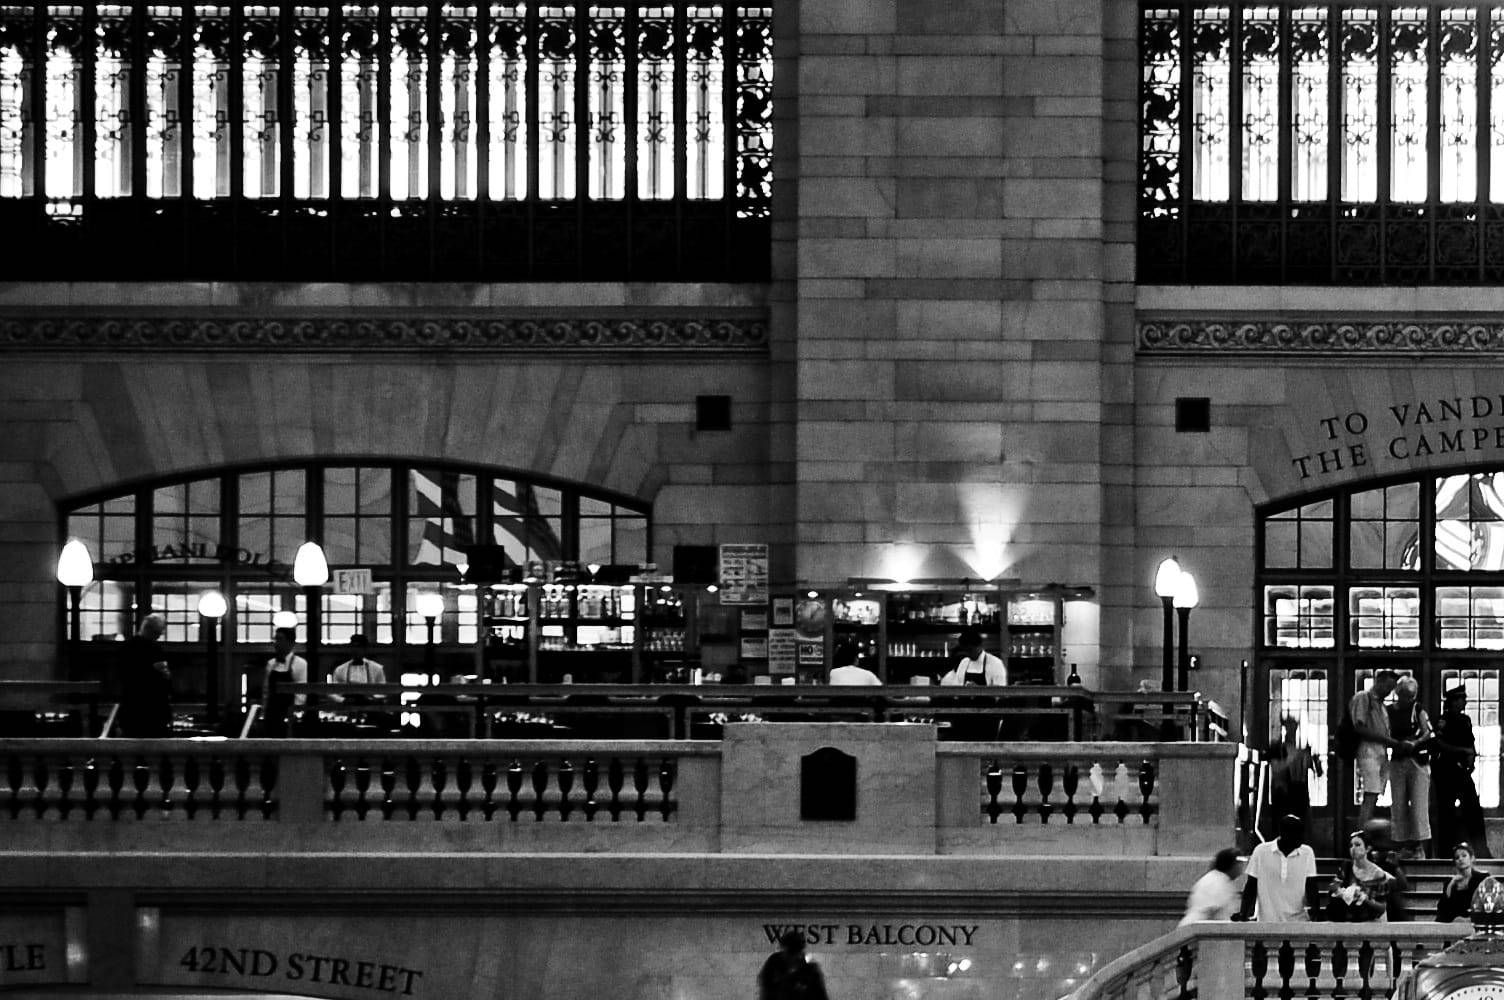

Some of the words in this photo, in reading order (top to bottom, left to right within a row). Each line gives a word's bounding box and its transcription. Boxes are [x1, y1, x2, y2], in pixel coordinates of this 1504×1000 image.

[1320, 412, 1368, 440] TO
[1292, 444, 1367, 478] THE
[846, 924, 979, 946] BALCONY
[181, 946, 278, 977] 42ND
[286, 952, 423, 995] STREET
